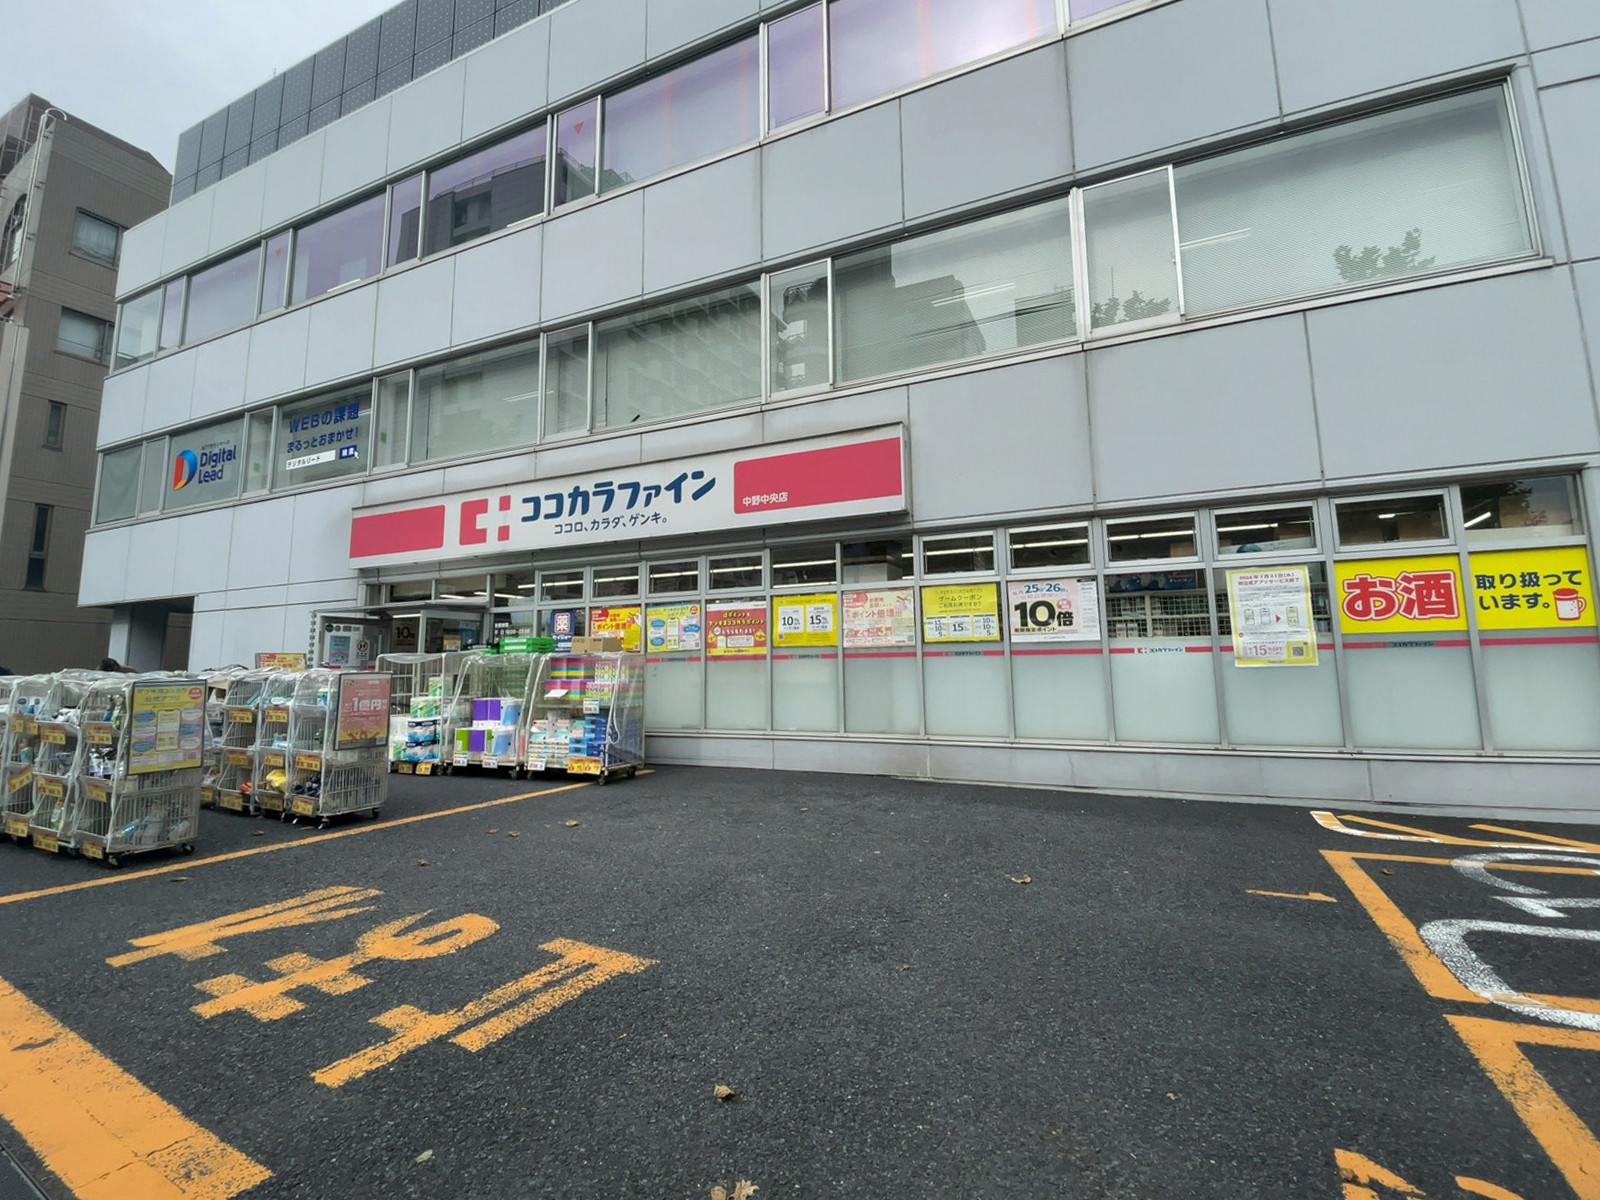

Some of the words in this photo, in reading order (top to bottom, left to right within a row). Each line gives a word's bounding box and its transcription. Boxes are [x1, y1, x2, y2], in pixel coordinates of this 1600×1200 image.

[289, 402, 360, 433] WEBの課題
[200, 446, 237, 469] Digital
[198, 468, 224, 484] Lead
[521, 470, 716, 522] ココカラファイン
[742, 491, 788, 506] 中野中央店
[554, 511, 667, 534] ココロ、カラダ、ゲンキ。
[1475, 570, 1583, 590] 取り扱って
[1342, 569, 1460, 622] お酒
[1478, 592, 1550, 611] います。
[1014, 600, 1074, 627] 10倍
